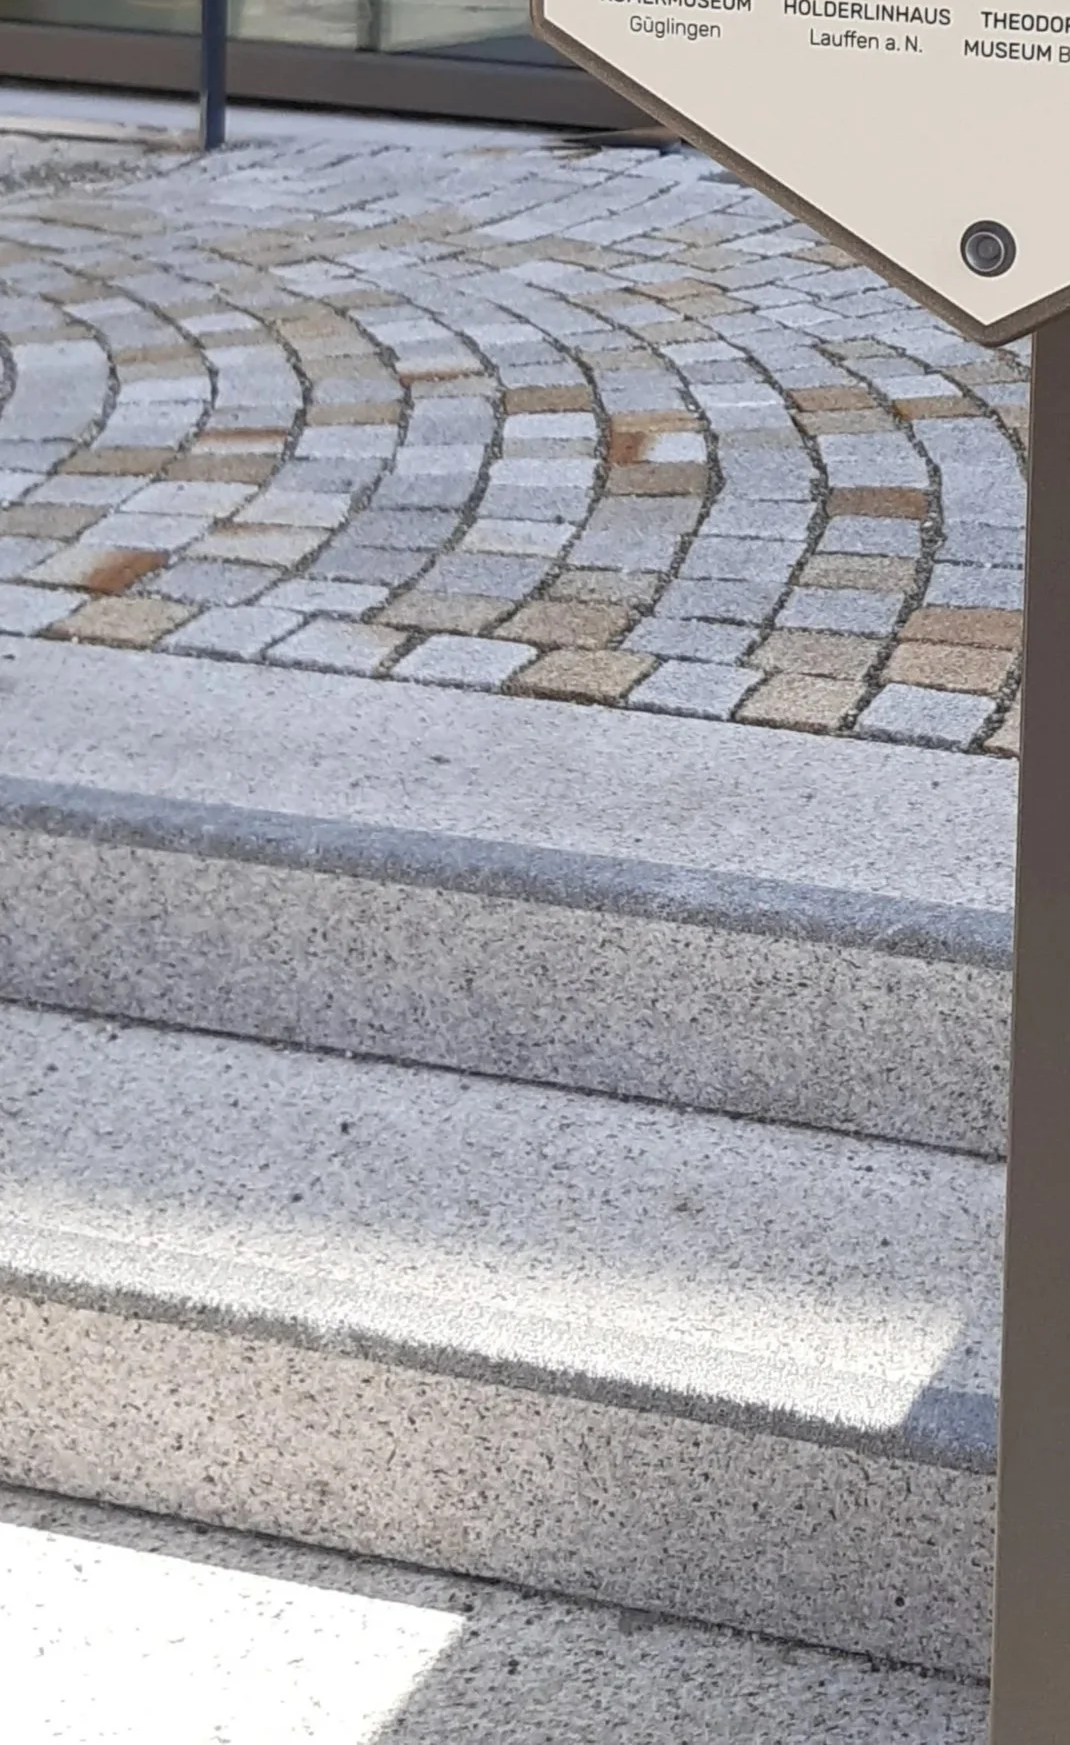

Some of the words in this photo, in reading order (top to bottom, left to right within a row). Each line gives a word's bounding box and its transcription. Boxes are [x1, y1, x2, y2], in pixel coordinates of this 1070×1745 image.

[629, 15, 721, 41] Güglingen
[809, 28, 879, 50] Lauffen
[885, 37, 901, 52] a.
[905, 35, 923, 54] N.
[963, 39, 1052, 62] MUSEUM
